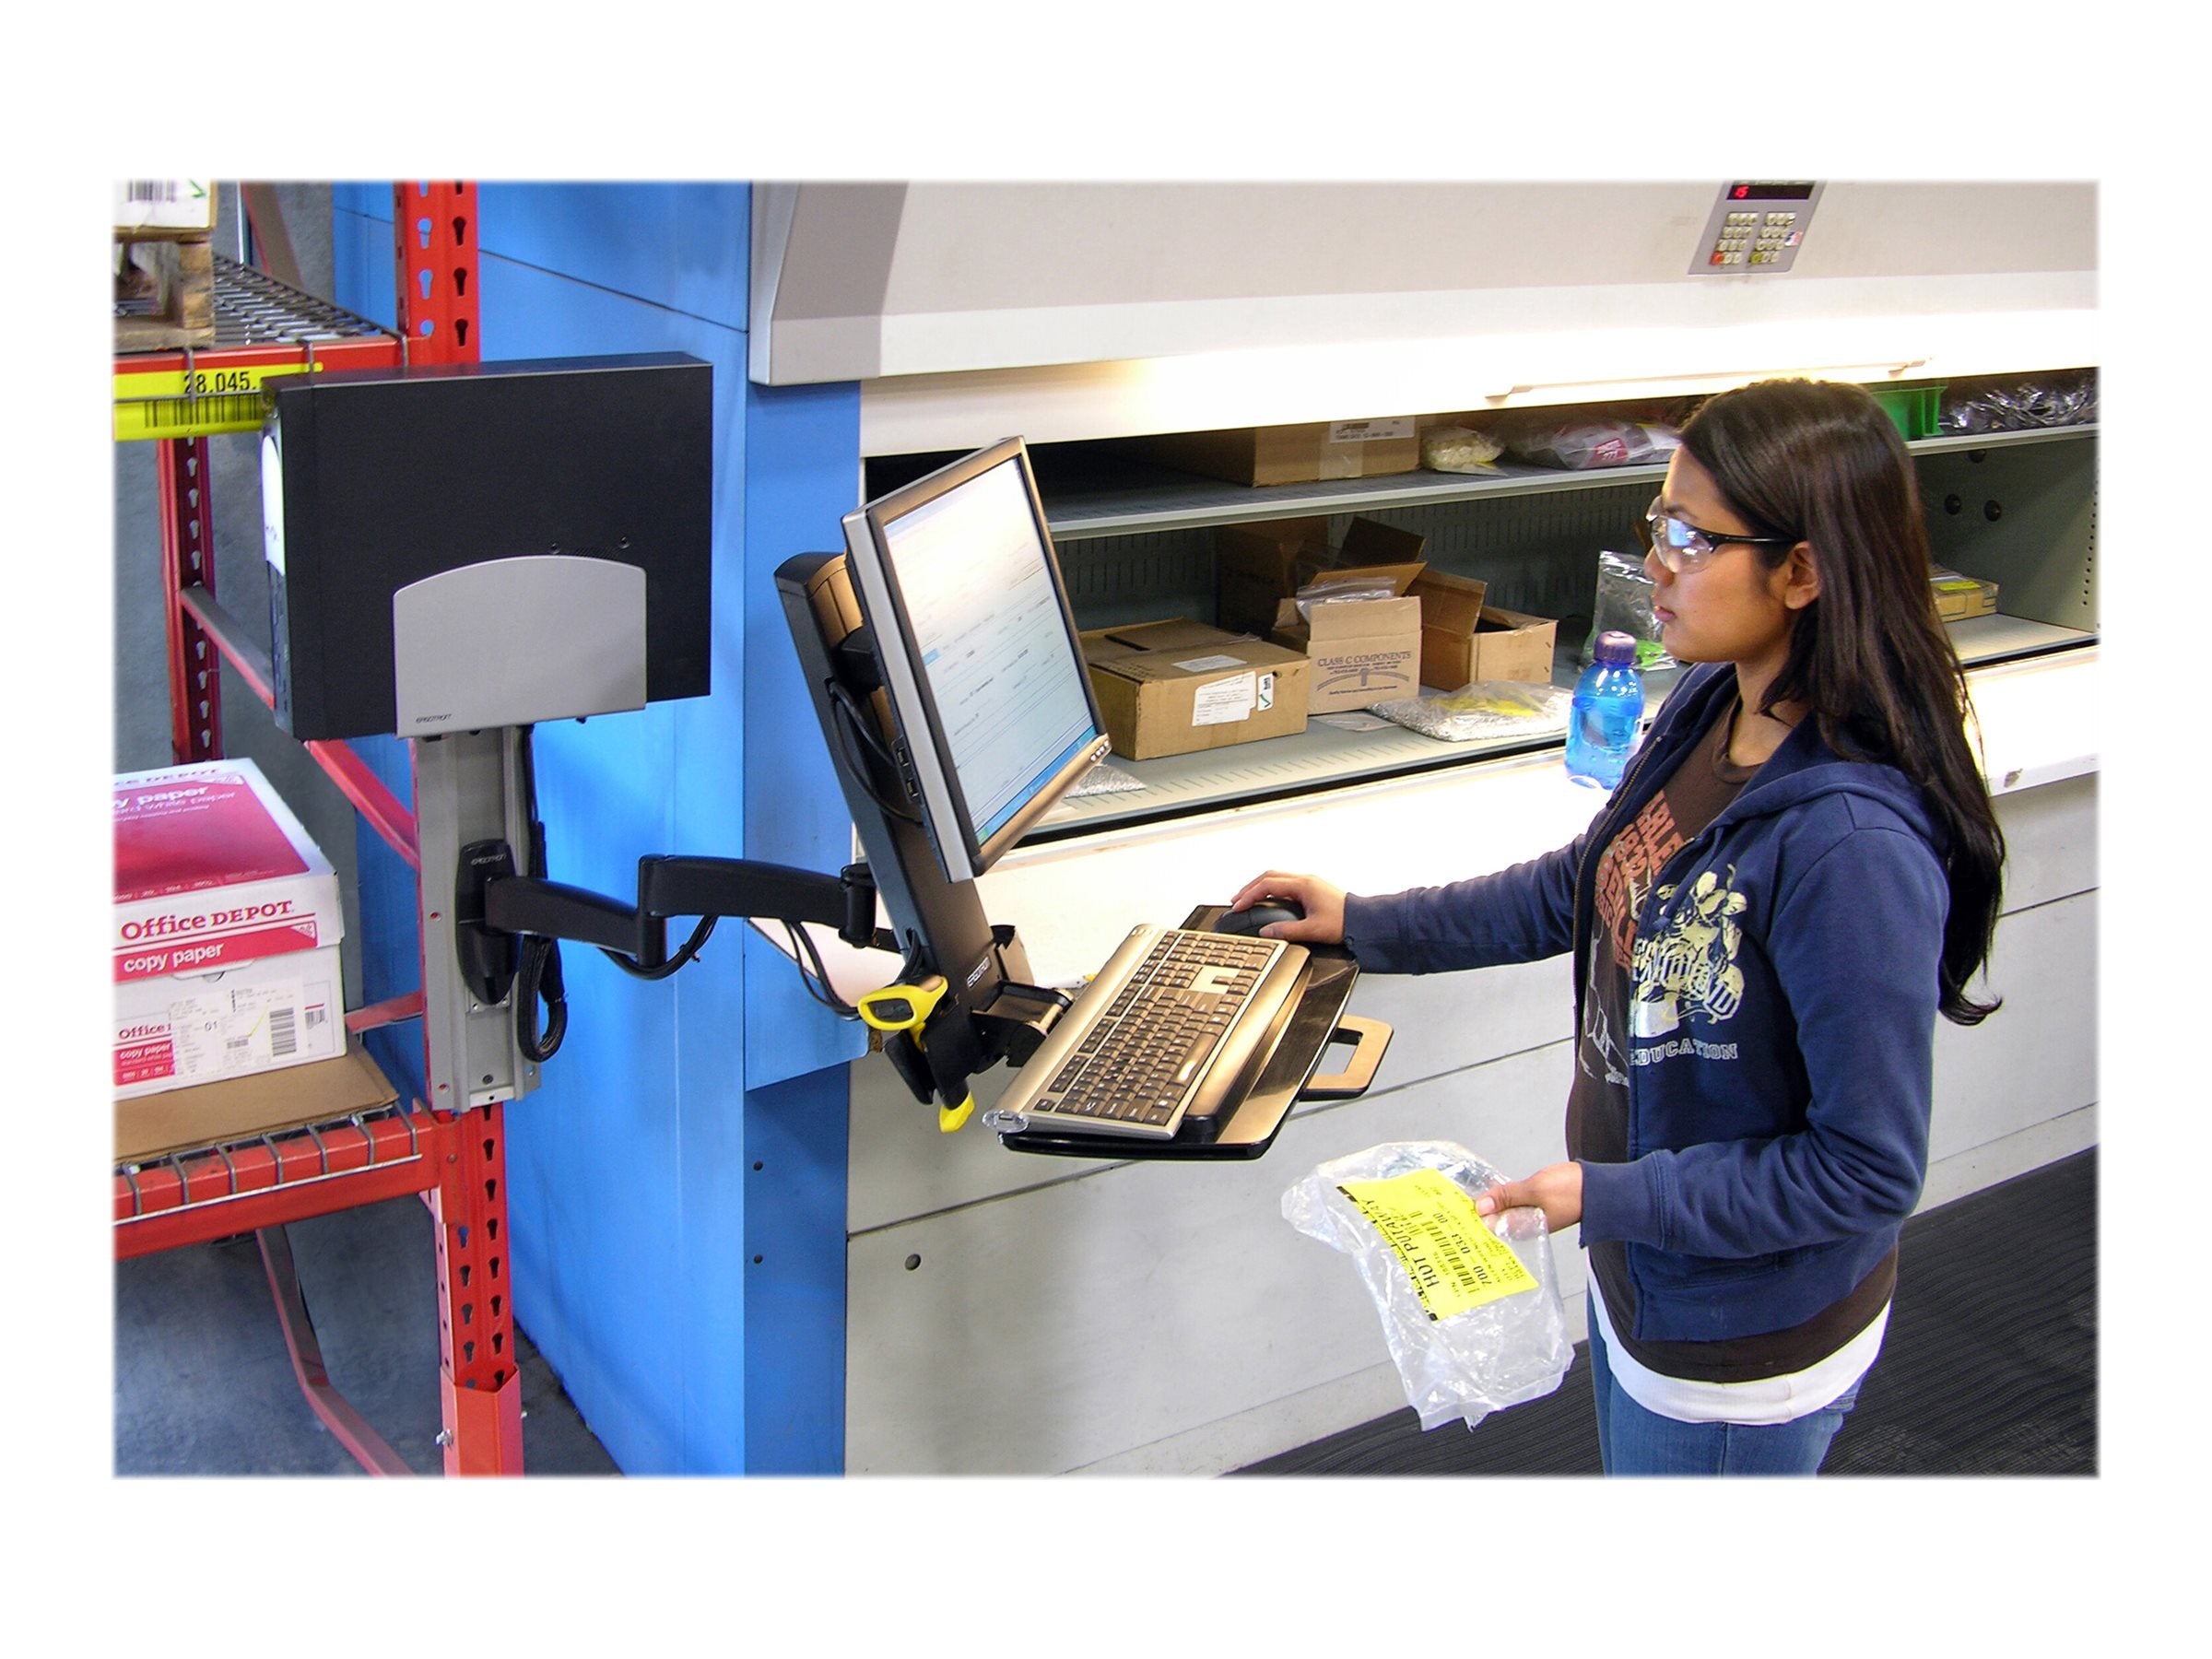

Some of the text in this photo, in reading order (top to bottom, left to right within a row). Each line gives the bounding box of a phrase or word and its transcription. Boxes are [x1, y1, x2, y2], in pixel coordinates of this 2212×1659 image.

[1318, 651, 1411, 666] CLASS C COMPONENTS
[121, 900, 292, 940] Office DEPOT
[124, 943, 224, 972] copy paper
[119, 1025, 165, 1040] Office
[1413, 1255, 1440, 1287] HOT
